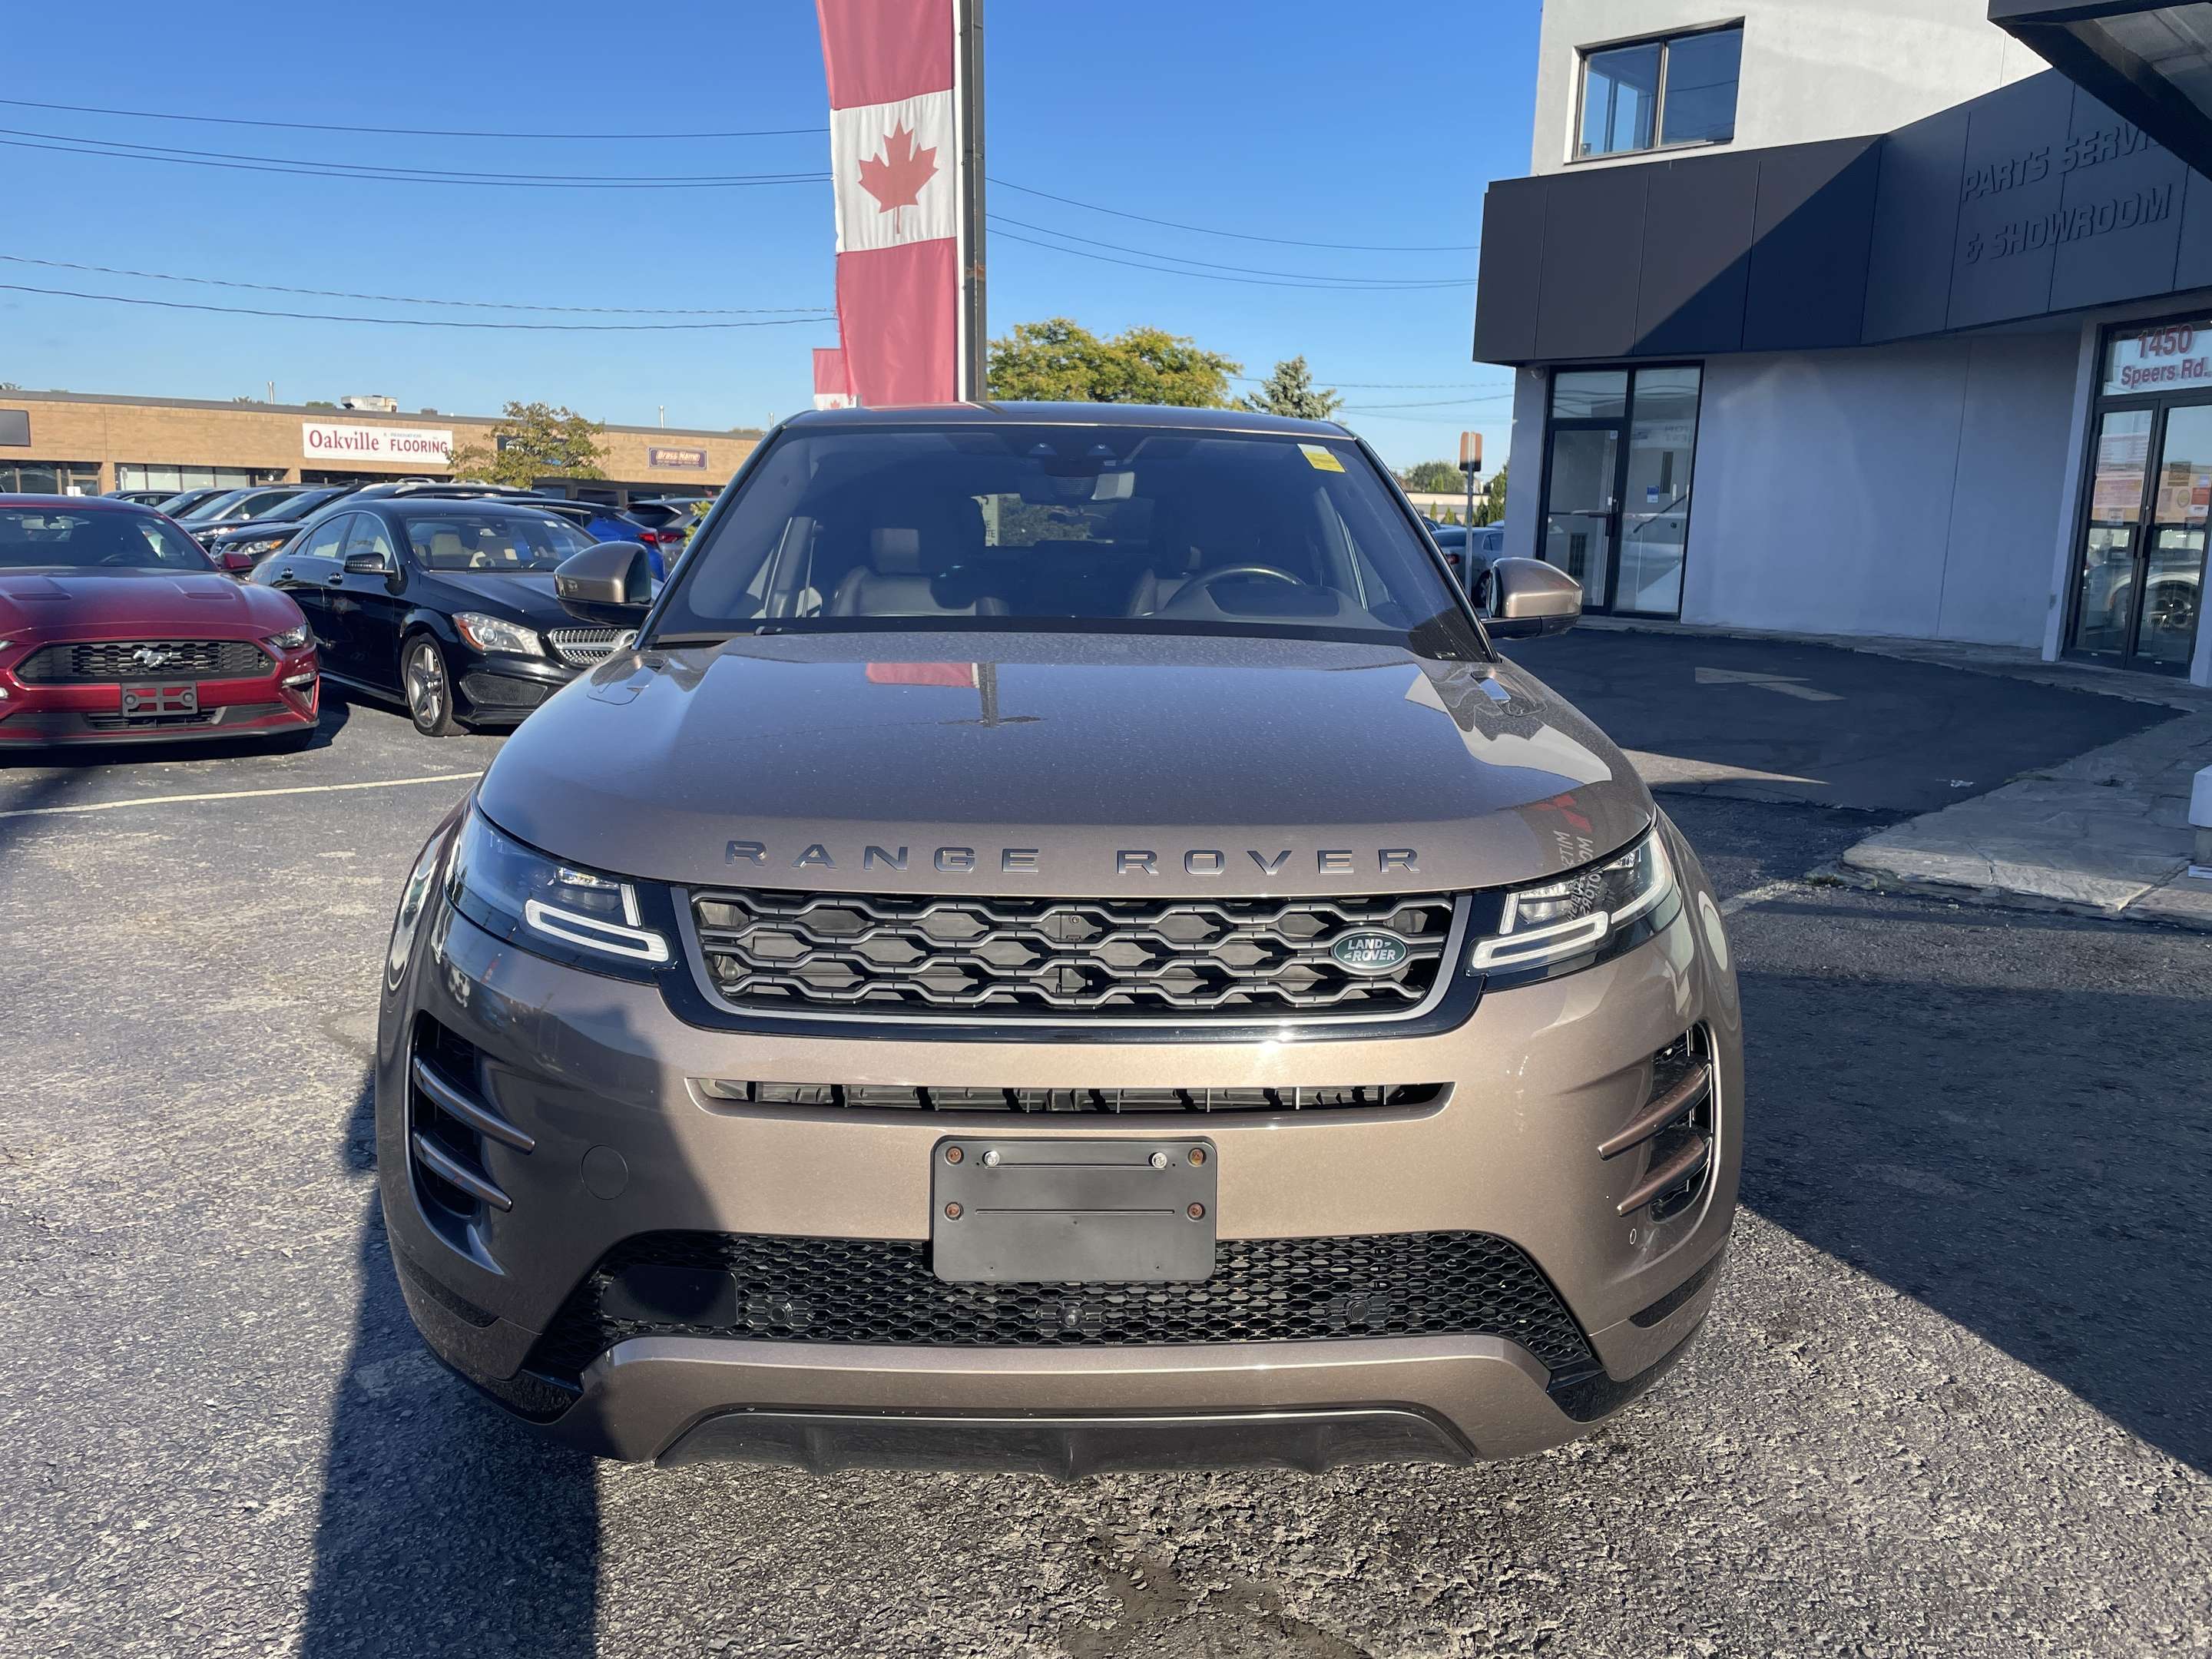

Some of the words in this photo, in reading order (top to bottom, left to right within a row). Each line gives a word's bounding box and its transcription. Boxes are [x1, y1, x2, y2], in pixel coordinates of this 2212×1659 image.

[1961, 145, 2050, 203] PARTS
[1966, 233, 1985, 265] &
[1990, 183, 2173, 260] SHOWROOM
[2137, 323, 2193, 359] 1450
[2121, 365, 2176, 389] Speers
[2181, 357, 2210, 379] Rd.
[309, 429, 379, 451] Oakville
[390, 439, 449, 455] FLOORING
[724, 839, 1039, 874] RANGE
[1116, 848, 1420, 876] ROVER
[1347, 939, 1383, 950] LAND
[1352, 949, 1396, 962] ROVER
